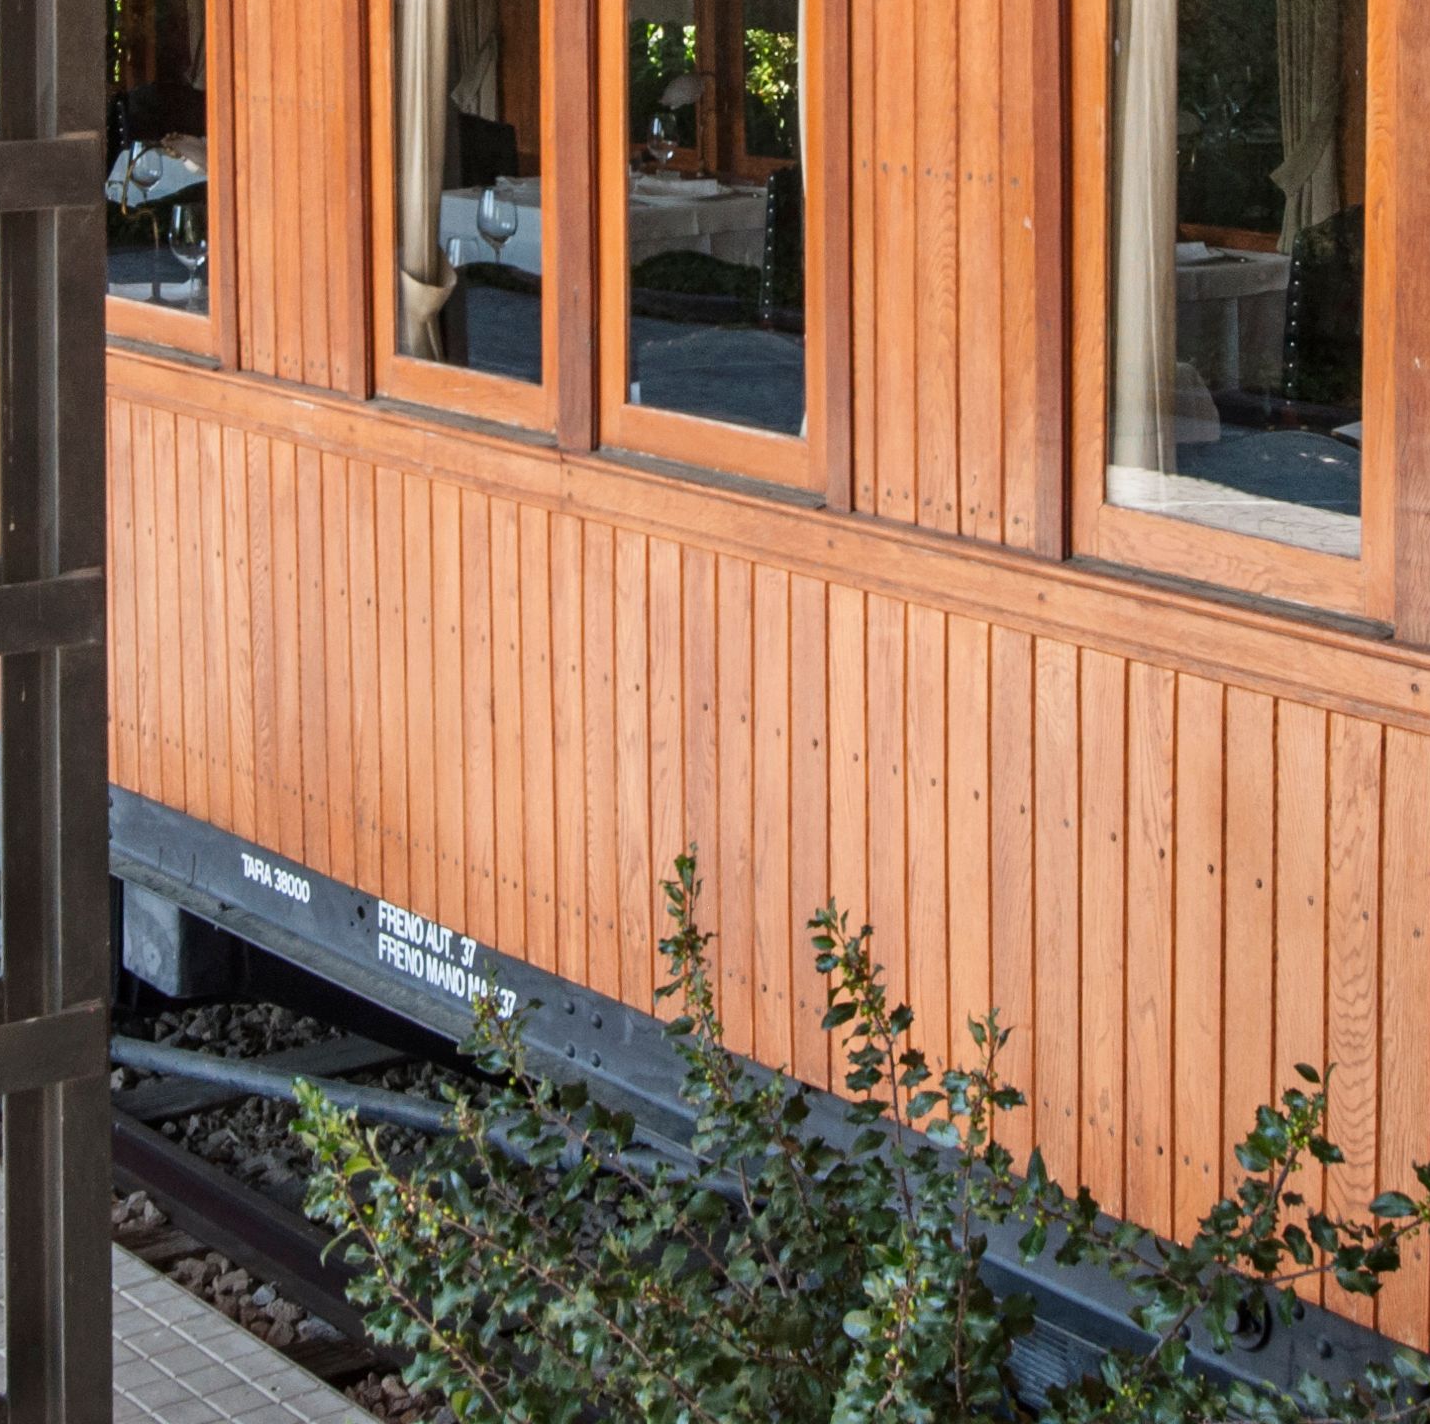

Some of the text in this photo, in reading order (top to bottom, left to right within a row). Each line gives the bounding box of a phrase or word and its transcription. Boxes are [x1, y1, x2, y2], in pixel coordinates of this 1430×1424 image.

[241, 852, 311, 903] TARA 38000
[378, 899, 477, 968] FRENO AUT. 37
[378, 932, 424, 978] FRENO
[426, 953, 466, 998] MANO
[499, 988, 517, 1019] 37
